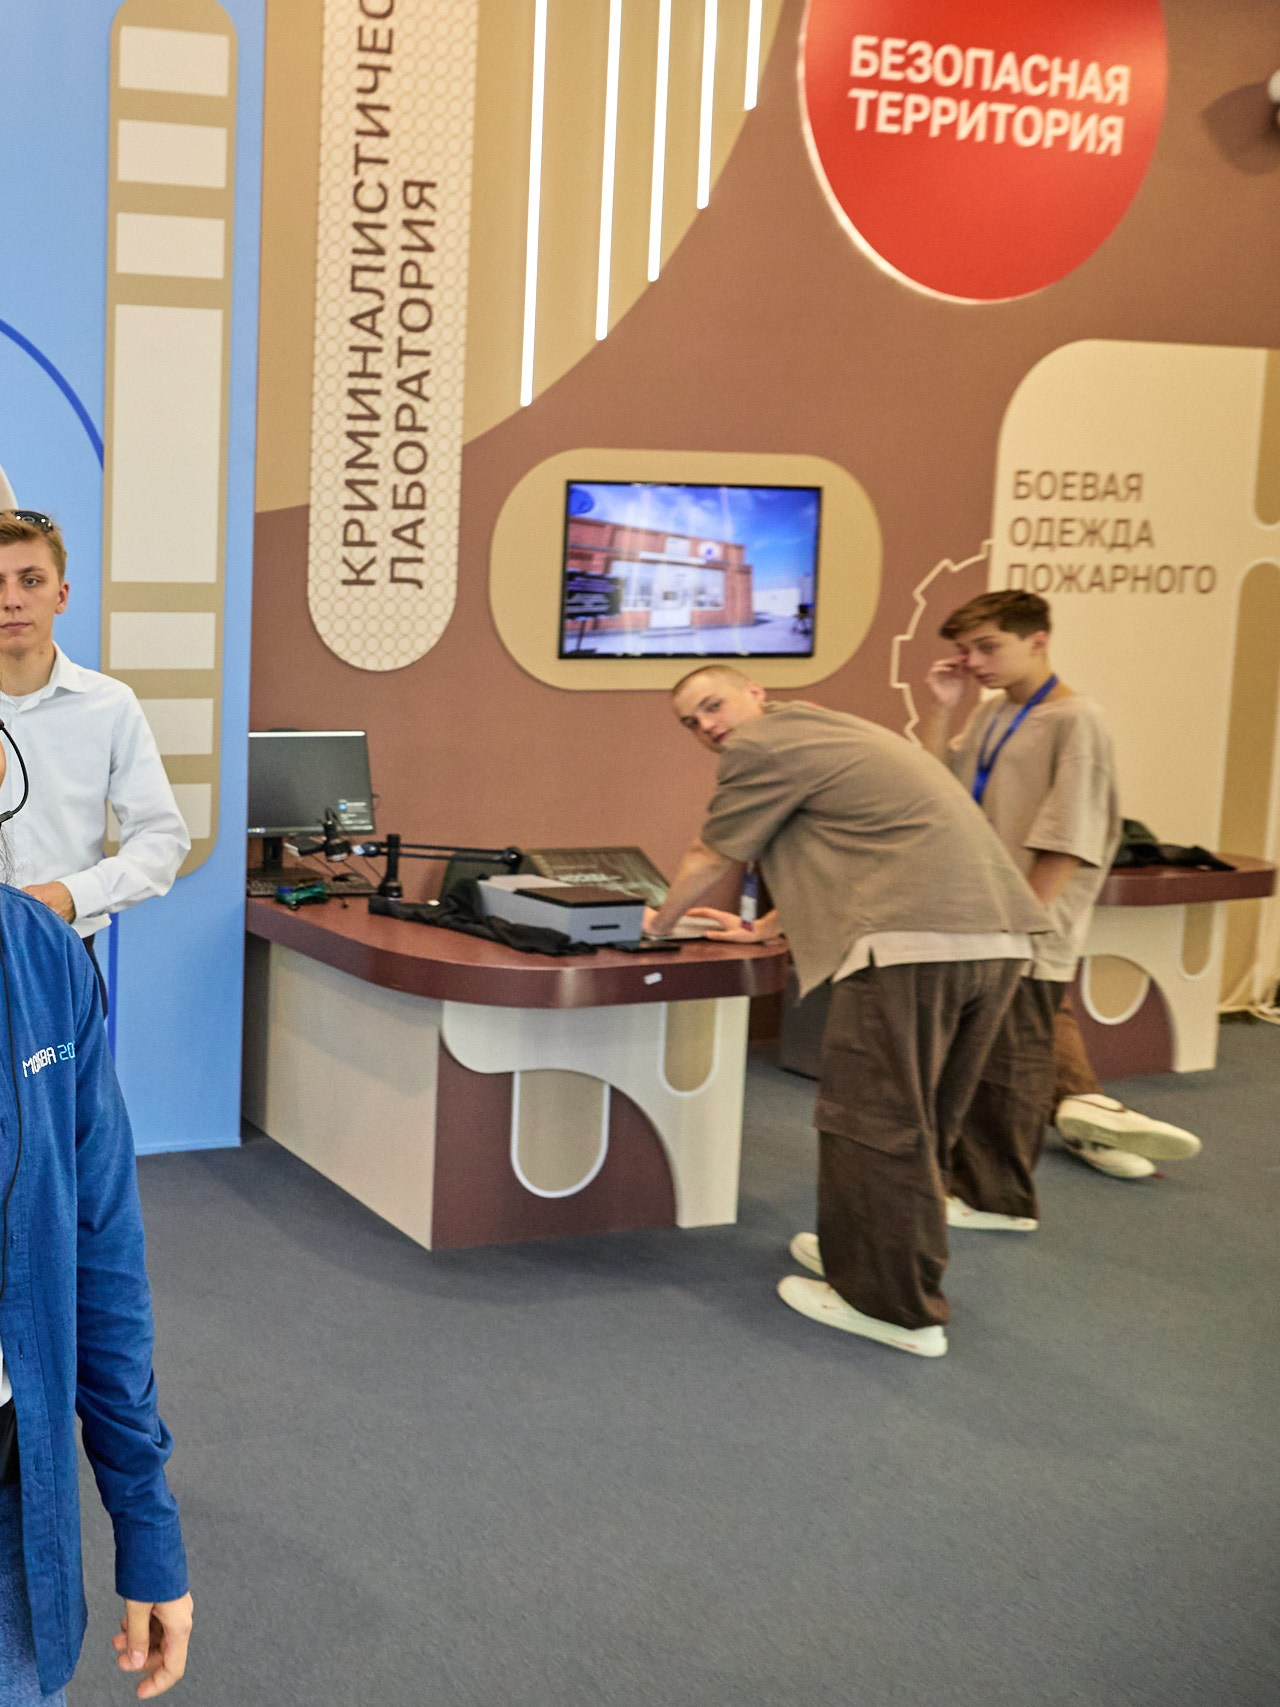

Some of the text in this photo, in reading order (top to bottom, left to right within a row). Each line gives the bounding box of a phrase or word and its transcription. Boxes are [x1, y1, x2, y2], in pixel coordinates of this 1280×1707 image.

[849, 34, 1131, 106] БЕЗОПАСНАЯ
[847, 87, 1124, 156] ТЕРРИТОРИЯ
[389, 179, 437, 589] ЛАБОРАТОРИЯ
[1013, 469, 1144, 501] БОЕВАЯ
[1009, 516, 1155, 551] ОДЕЖДА
[1006, 563, 1218, 594] ПОЖАРНОГО
[57, 1041, 76, 1060] 20
